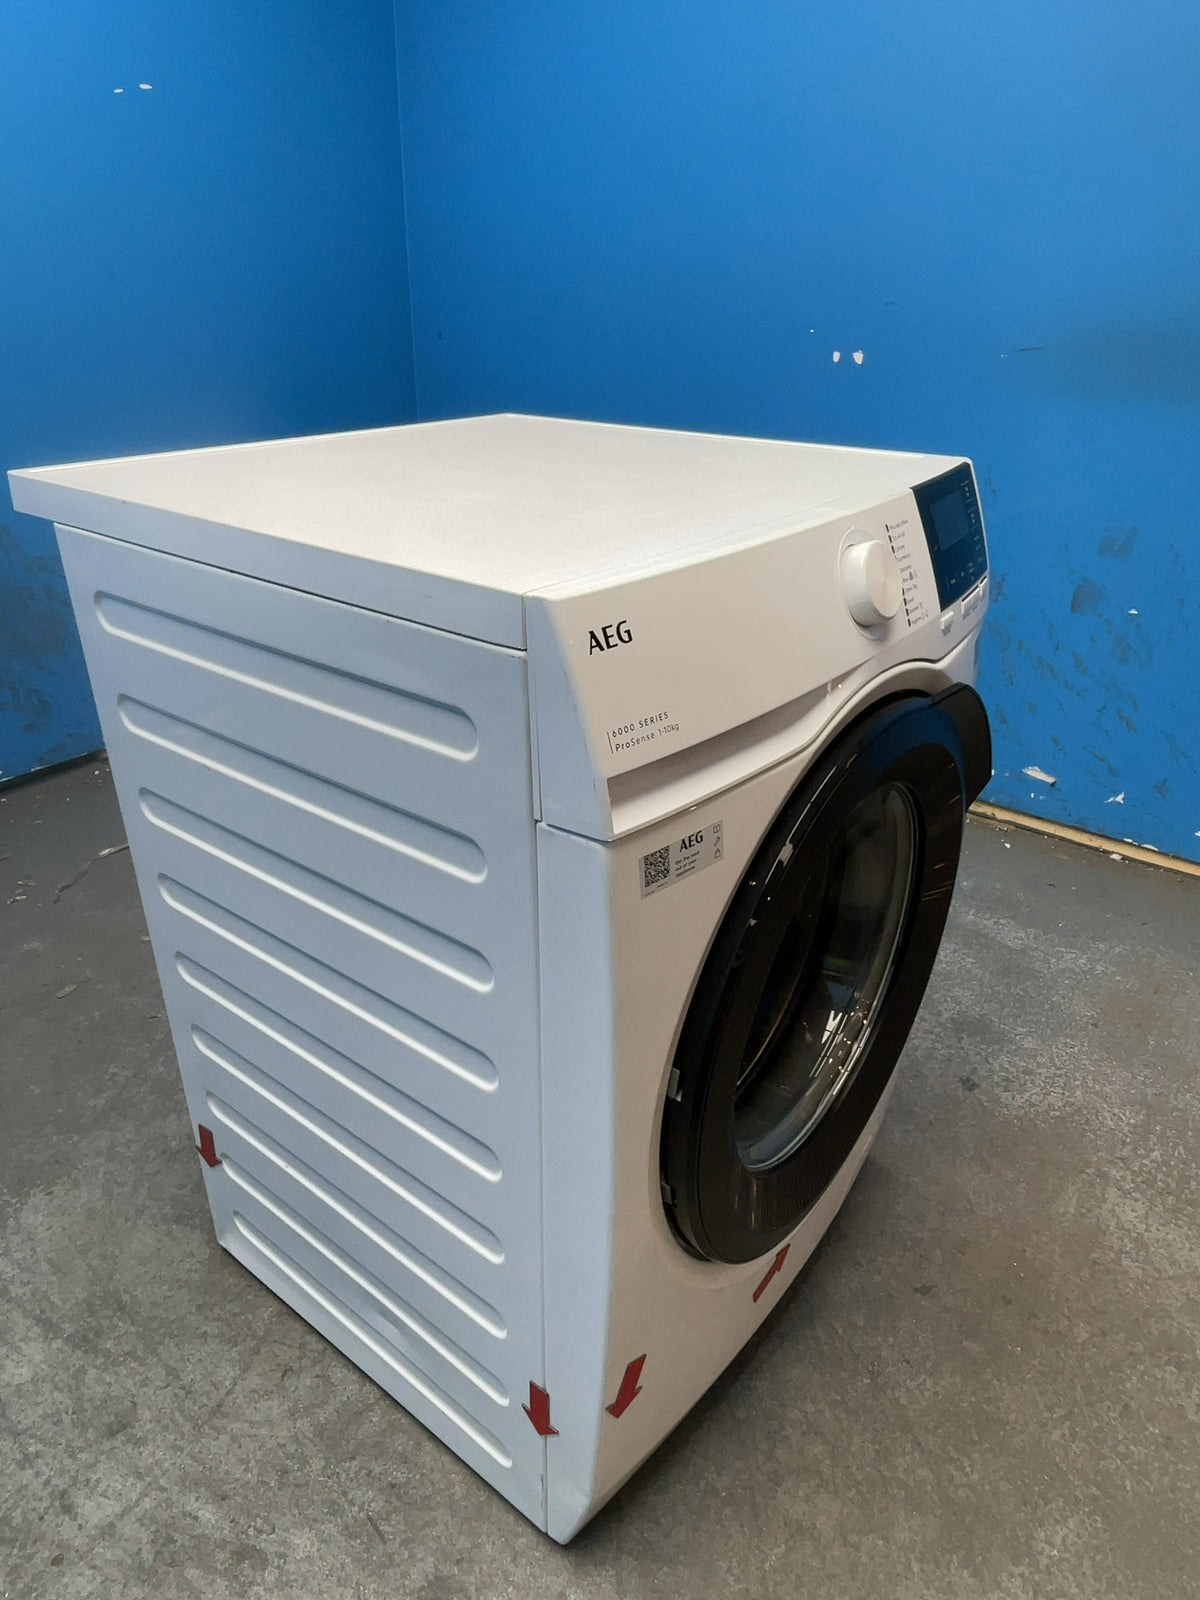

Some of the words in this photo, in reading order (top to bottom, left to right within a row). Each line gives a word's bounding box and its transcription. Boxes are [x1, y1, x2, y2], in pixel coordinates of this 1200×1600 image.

[588, 620, 633, 655] AEG
[611, 723, 635, 738] 6000
[638, 711, 669, 729] SERIES
[615, 731, 655, 752] ProSense
[658, 723, 680, 737] 1-10kg
[680, 830, 704, 852] AEG
